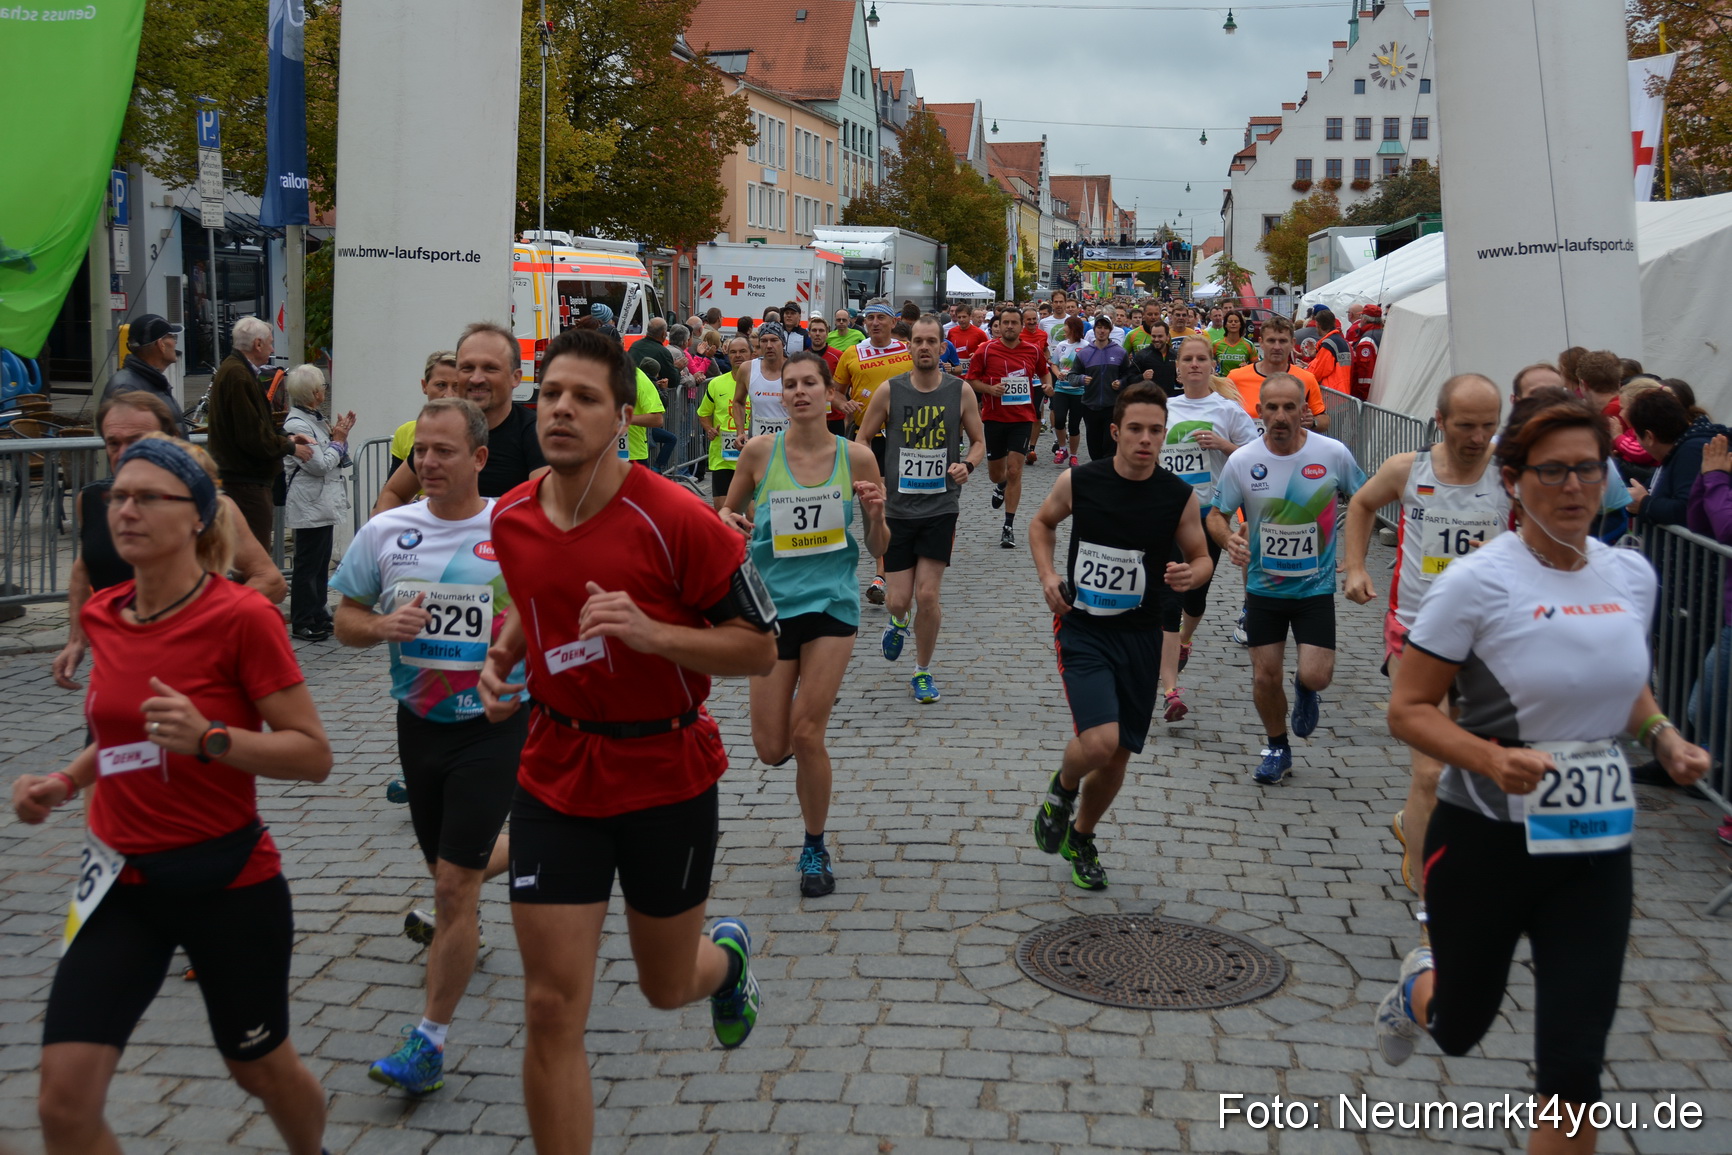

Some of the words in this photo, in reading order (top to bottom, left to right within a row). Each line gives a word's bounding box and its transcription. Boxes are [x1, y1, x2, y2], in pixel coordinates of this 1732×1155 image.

[150, 243, 158, 261] 3
[337, 245, 481, 263] www.bmw-laufsport.de
[1477, 238, 1634, 259] www.bmw-laufsport.de
[748, 275, 786, 283] Bayerisches
[860, 360, 885, 370] MAX
[888, 354, 912, 365] BÖGL
[1004, 383, 1028, 395] 2568
[902, 405, 945, 428] RUN
[902, 427, 946, 450] THIS
[904, 459, 943, 477] 2176
[1164, 453, 1204, 473] 3021
[907, 480, 939, 488] Alexander
[771, 496, 794, 504] PARTL
[795, 494, 831, 503] Neumarkt
[793, 504, 822, 531] 37
[1424, 515, 1450, 525] PARTL
[1451, 518, 1491, 527] Neumarkt
[1261, 527, 1278, 535] PARTL
[791, 535, 828, 547] Sabrina
[1265, 536, 1313, 557] 2274
[392, 553, 419, 561] PARTL
[1079, 547, 1100, 558] PARTL
[1101, 552, 1136, 564] Neumarkt
[1276, 560, 1302, 570] Hubert
[1080, 560, 1138, 592] 2521
[430, 591, 476, 602] Neumarkt
[1092, 594, 1117, 607] Timo
[1561, 602, 1627, 616] KLEBL
[420, 643, 462, 658] Patrick
[561, 646, 586, 664] DEHN
[112, 749, 142, 766] DEHN
[1539, 763, 1627, 808] 2372
[1568, 819, 1608, 835] Petra
